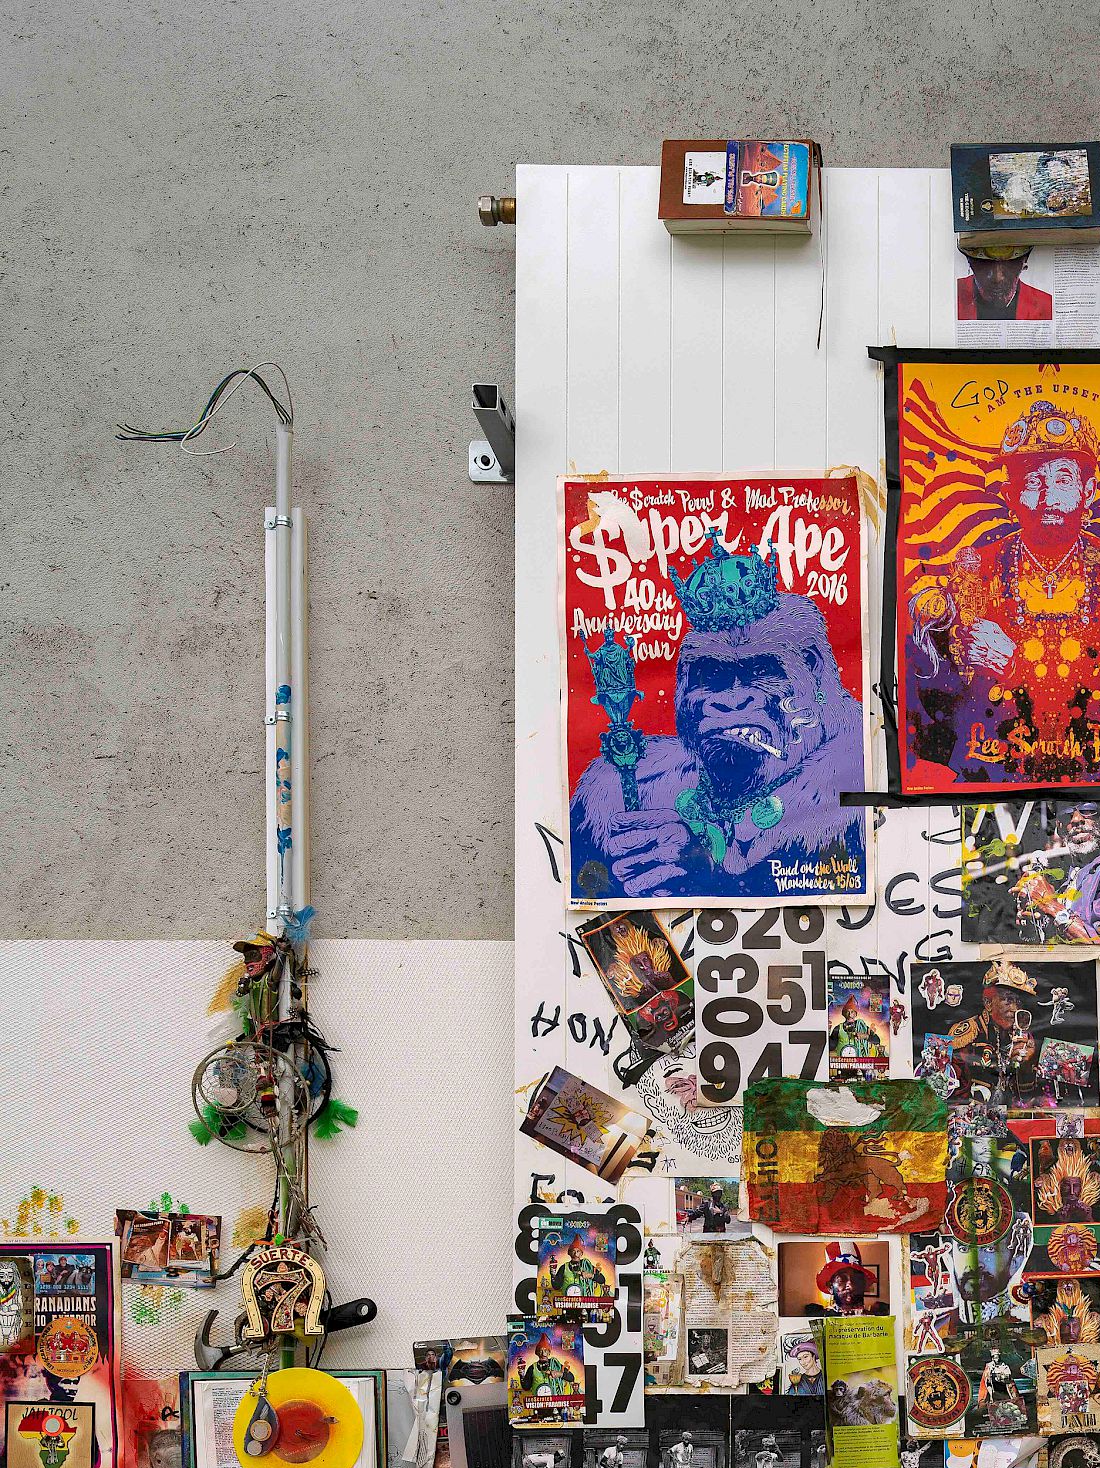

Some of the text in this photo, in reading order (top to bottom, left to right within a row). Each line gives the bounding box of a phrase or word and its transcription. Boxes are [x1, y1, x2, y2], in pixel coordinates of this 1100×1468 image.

[987, 398, 1006, 413] AM
[1014, 384, 1043, 399] THE
[676, 486, 852, 514] Perry & Mad Professor
[749, 505, 850, 590] Ape
[623, 578, 677, 614] 40th
[806, 571, 848, 606] 2016
[571, 607, 682, 640] Anniversary
[768, 859, 799, 877] Band
[775, 875, 834, 892] Manchester
[250, 1247, 311, 1268] SUERTE
[253, 1270, 311, 1332] 7
